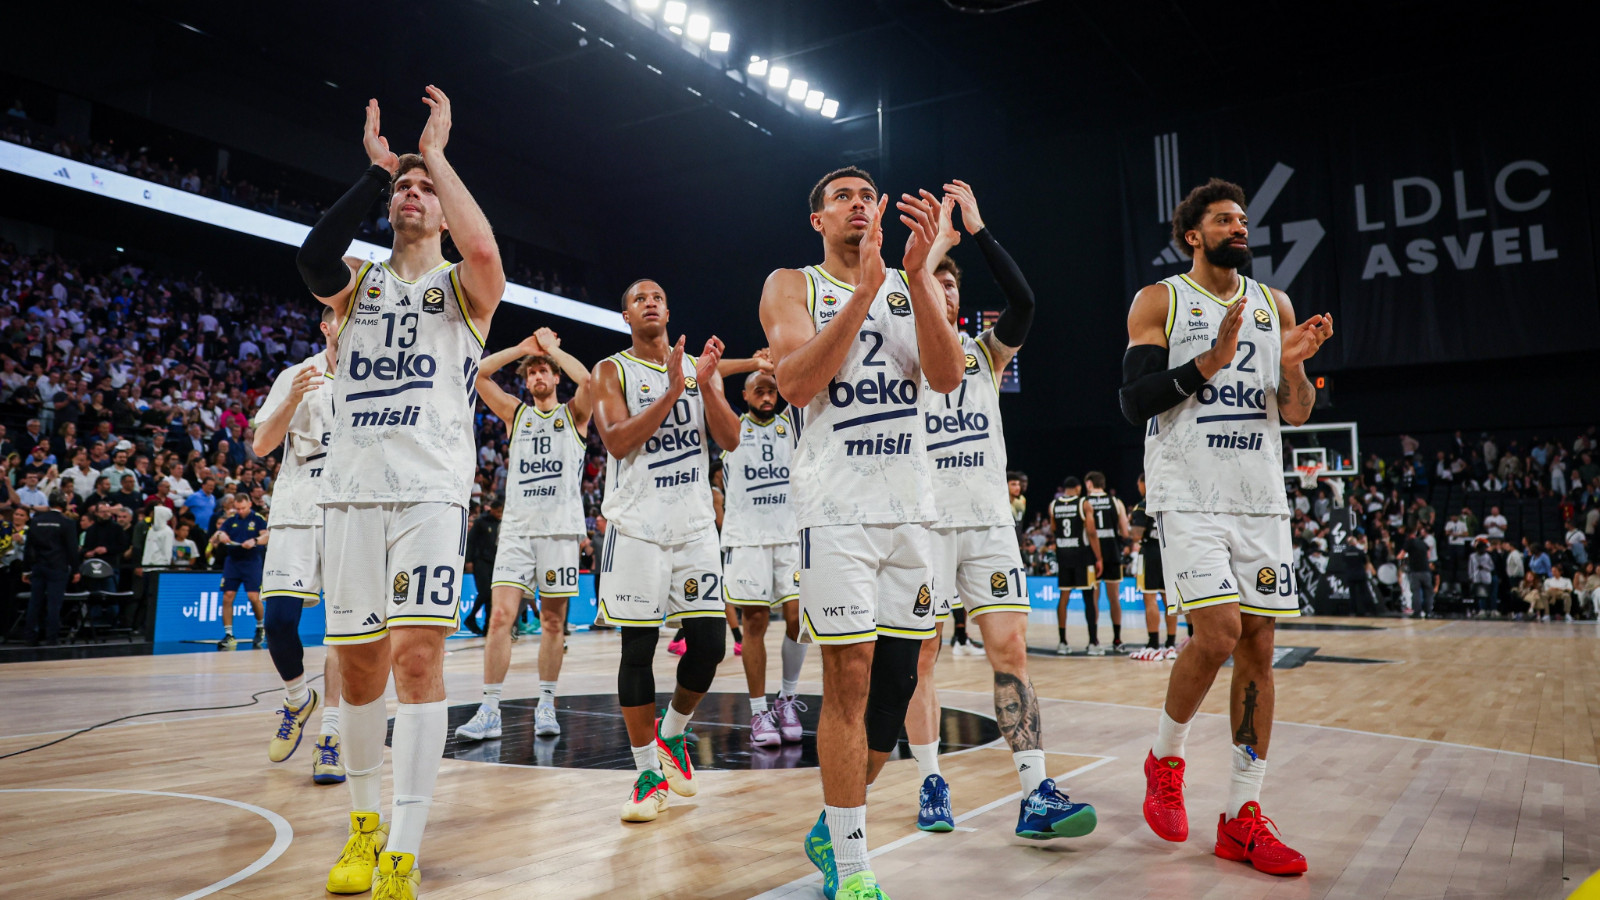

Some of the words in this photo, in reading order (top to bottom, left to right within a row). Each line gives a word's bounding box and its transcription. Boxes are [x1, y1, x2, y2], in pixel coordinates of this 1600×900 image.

[1355, 160, 1551, 231] LDLC
[1362, 225, 1558, 279] ASVEL
[359, 302, 381, 311] beko
[355, 318, 378, 326] RAMS
[382, 313, 418, 348] 13
[860, 330, 886, 366] 2
[1187, 334, 1208, 343] RAMS
[350, 351, 437, 380] beko
[828, 373, 918, 408] beko
[352, 405, 421, 427] misli
[925, 409, 989, 433] beko
[532, 436, 551, 455] 18
[845, 433, 912, 456] misli
[1206, 431, 1263, 450] misli
[762, 444, 774, 462] 8
[935, 452, 984, 469] misli
[520, 458, 563, 478] beko
[655, 467, 699, 488] misli
[745, 464, 790, 480] beko
[523, 486, 557, 497] misli
[752, 493, 786, 505] misli
[1062, 518, 1071, 538] 3
[1096, 510, 1104, 529] 1
[413, 565, 455, 605] 13
[557, 567, 577, 586] 18
[702, 573, 724, 601] 2
[616, 594, 631, 602] YKT
[823, 607, 845, 616] YKT
